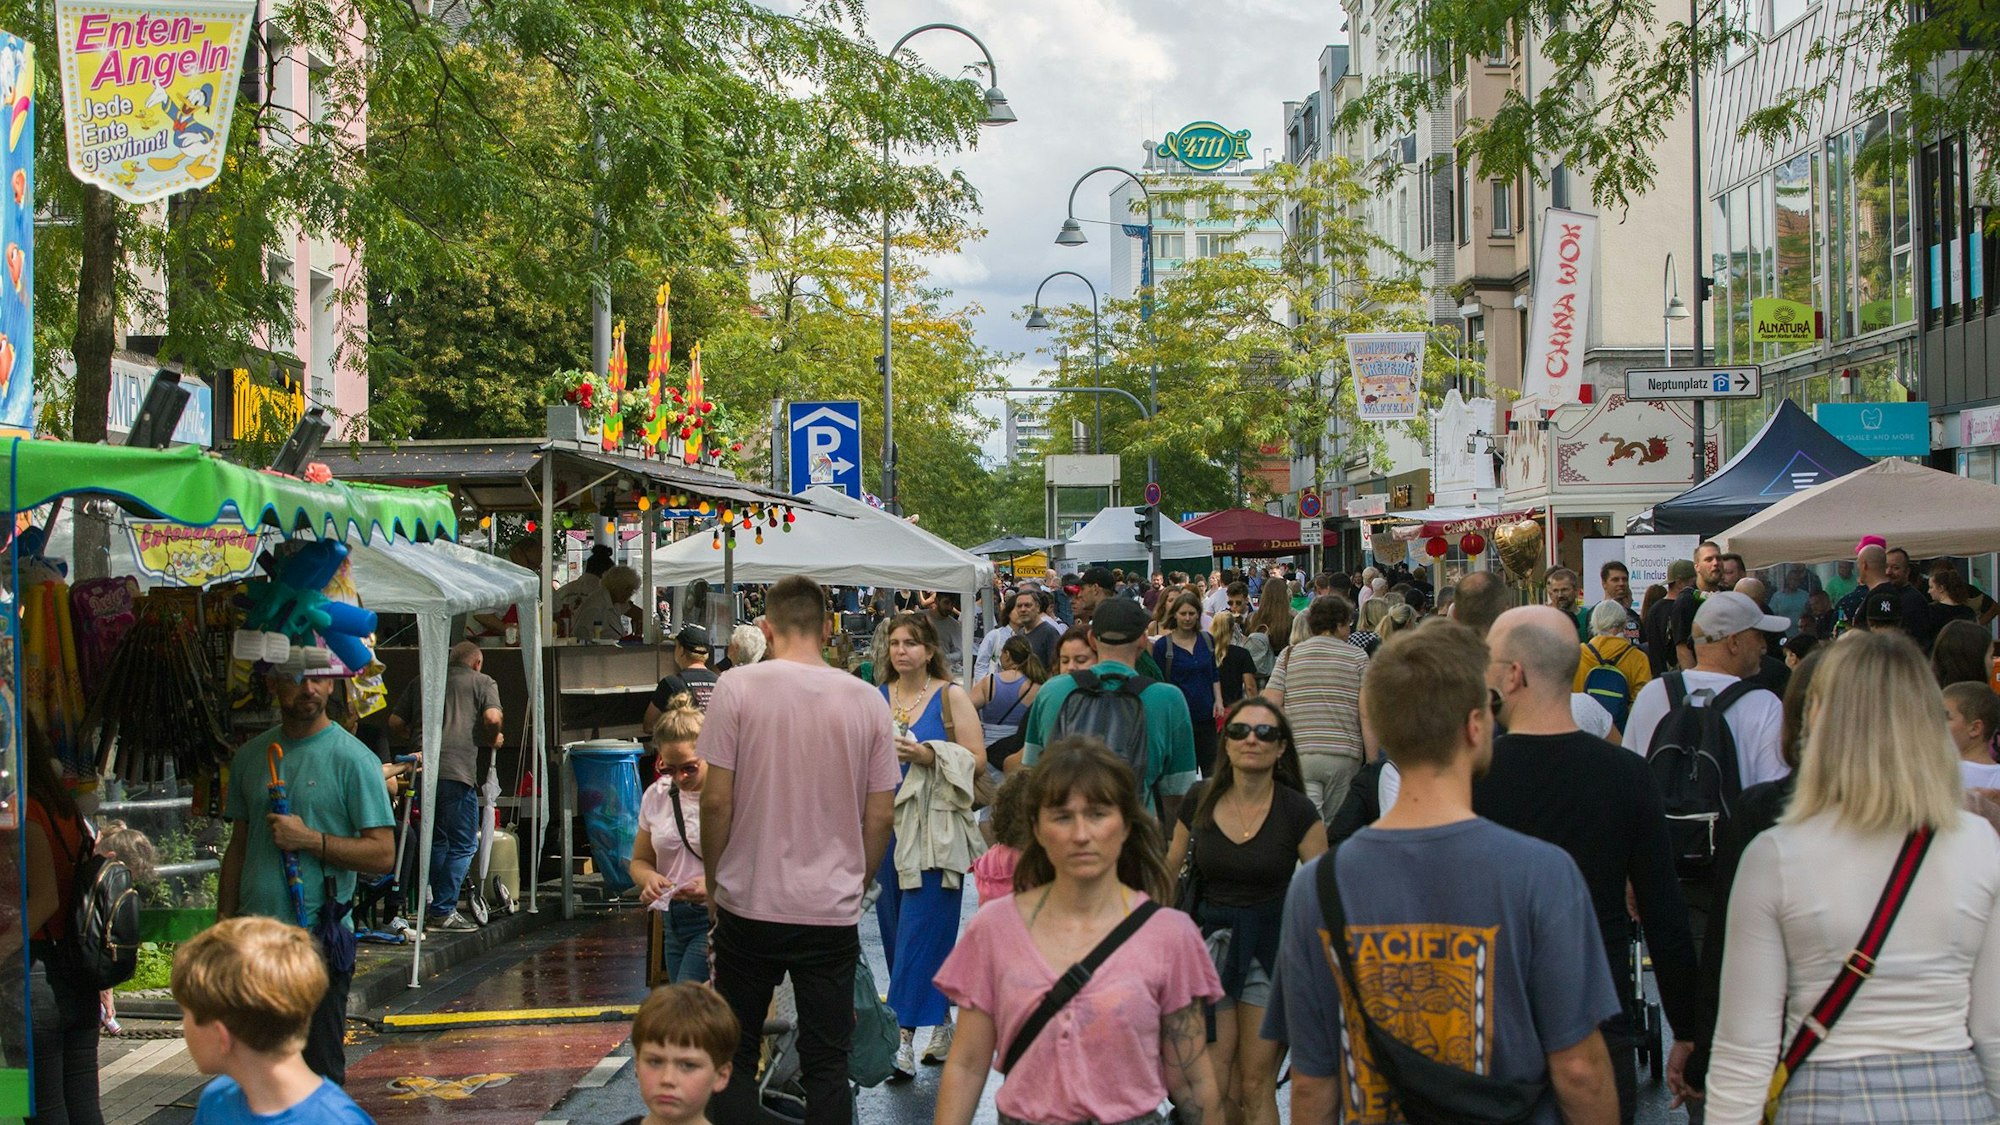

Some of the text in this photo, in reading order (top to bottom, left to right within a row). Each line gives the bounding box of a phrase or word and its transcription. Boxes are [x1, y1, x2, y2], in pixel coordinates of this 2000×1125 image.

[76, 12, 205, 53] Enten-
[90, 40, 230, 90] Angeln
[79, 94, 133, 122] Jede
[81, 120, 128, 147] Ente
[82, 129, 169, 172] gewinnt!
[1546, 223, 1582, 378] CHINA WOK
[1758, 320, 1811, 334] ALNATURA
[1648, 377, 1708, 392] Neptunplatz
[1847, 433, 1870, 441] SMILE
[1873, 433, 1889, 441] AND
[1631, 570, 1641, 580] All
[1346, 930, 1478, 964] ACIFIC
